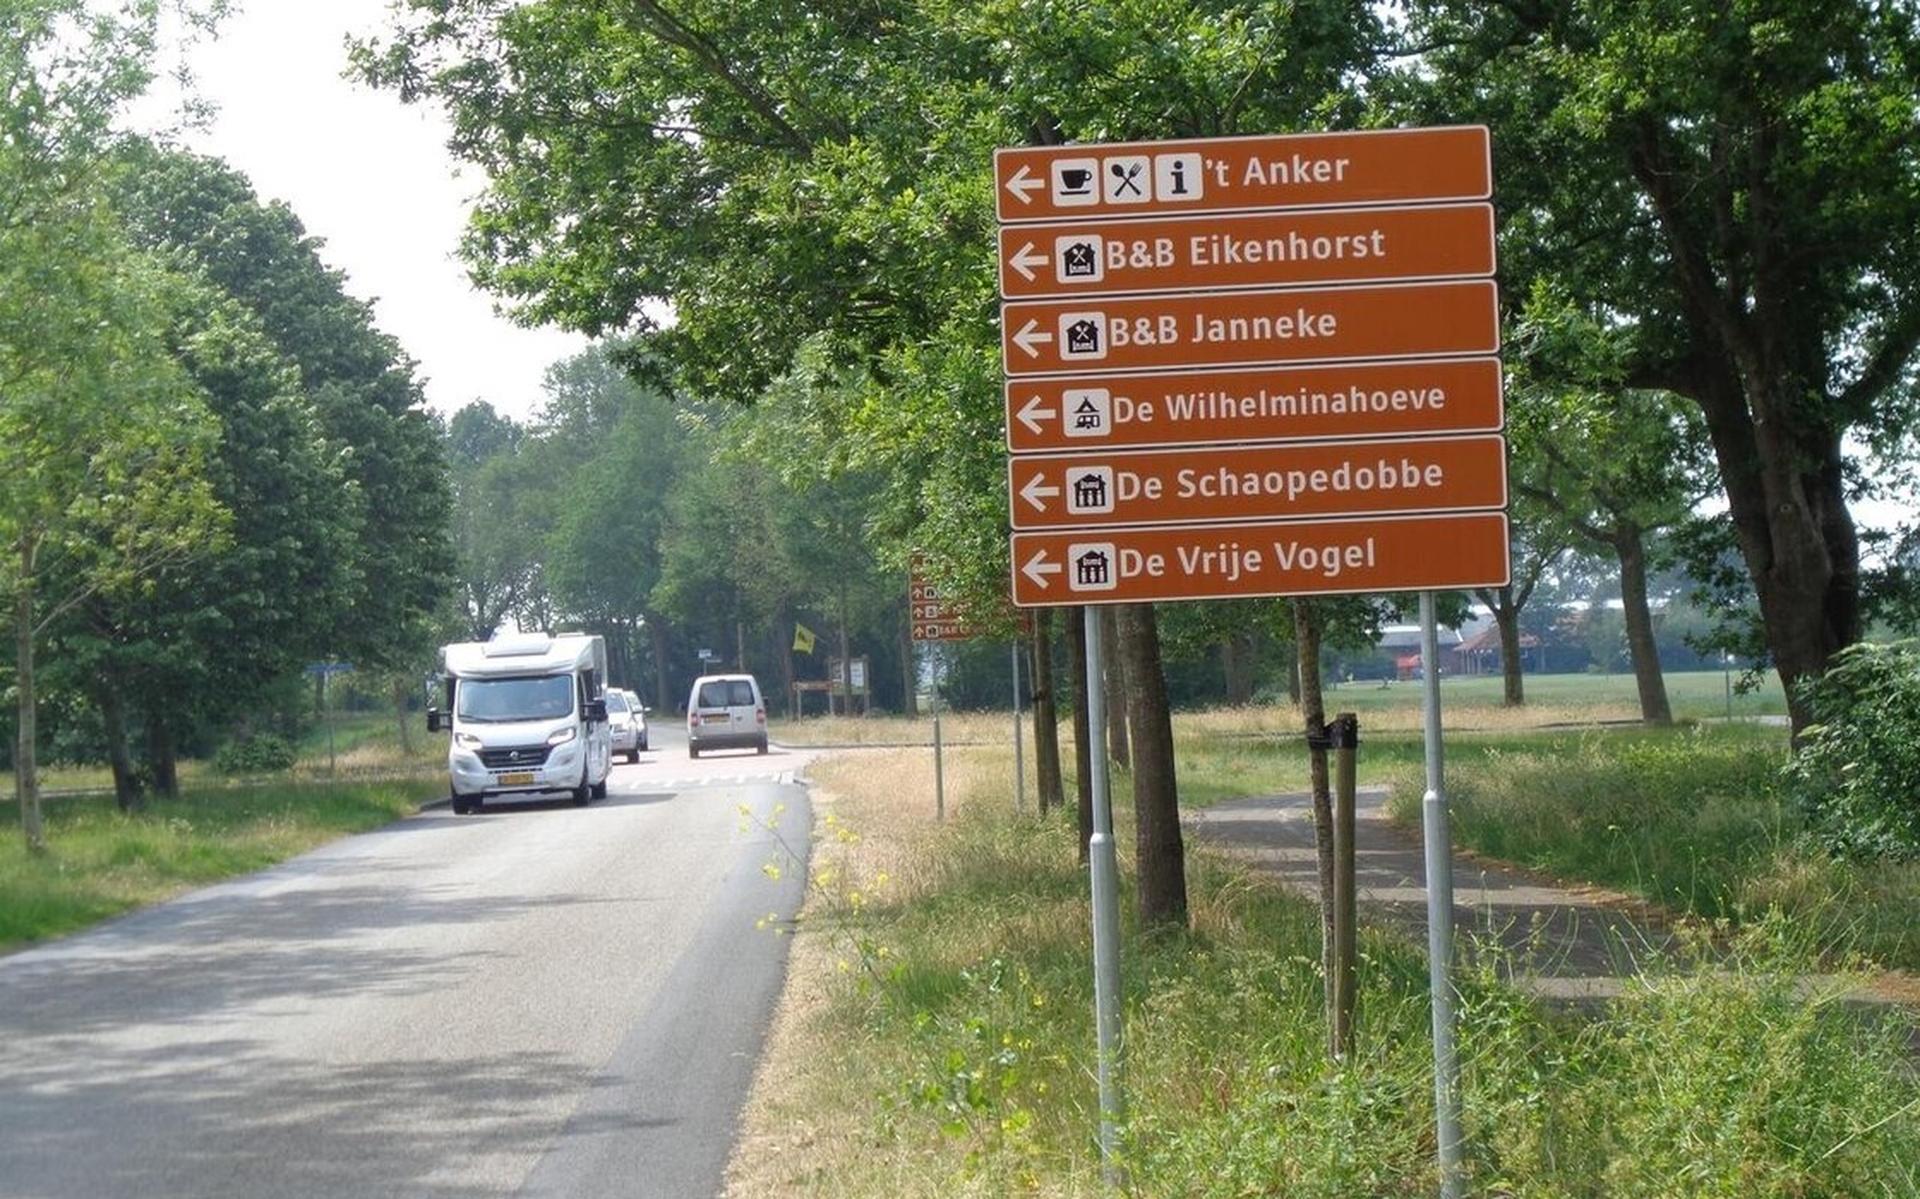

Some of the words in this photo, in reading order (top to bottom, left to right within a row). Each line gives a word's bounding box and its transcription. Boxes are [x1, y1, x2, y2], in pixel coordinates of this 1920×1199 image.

[1243, 154, 1350, 186] Anker
[1106, 238, 1175, 270] B&B
[1190, 229, 1386, 266] Eikenhorst
[1109, 315, 1179, 347] B&B
[1191, 308, 1337, 343] Janneke
[1113, 396, 1154, 424] De
[1164, 385, 1445, 421] Wilhelminahoeve
[1117, 471, 1163, 501] De
[1177, 458, 1443, 501] Schaopedobbe
[1119, 548, 1165, 578] De
[1176, 542, 1262, 581] Vrije
[1274, 537, 1375, 577] Vogel
